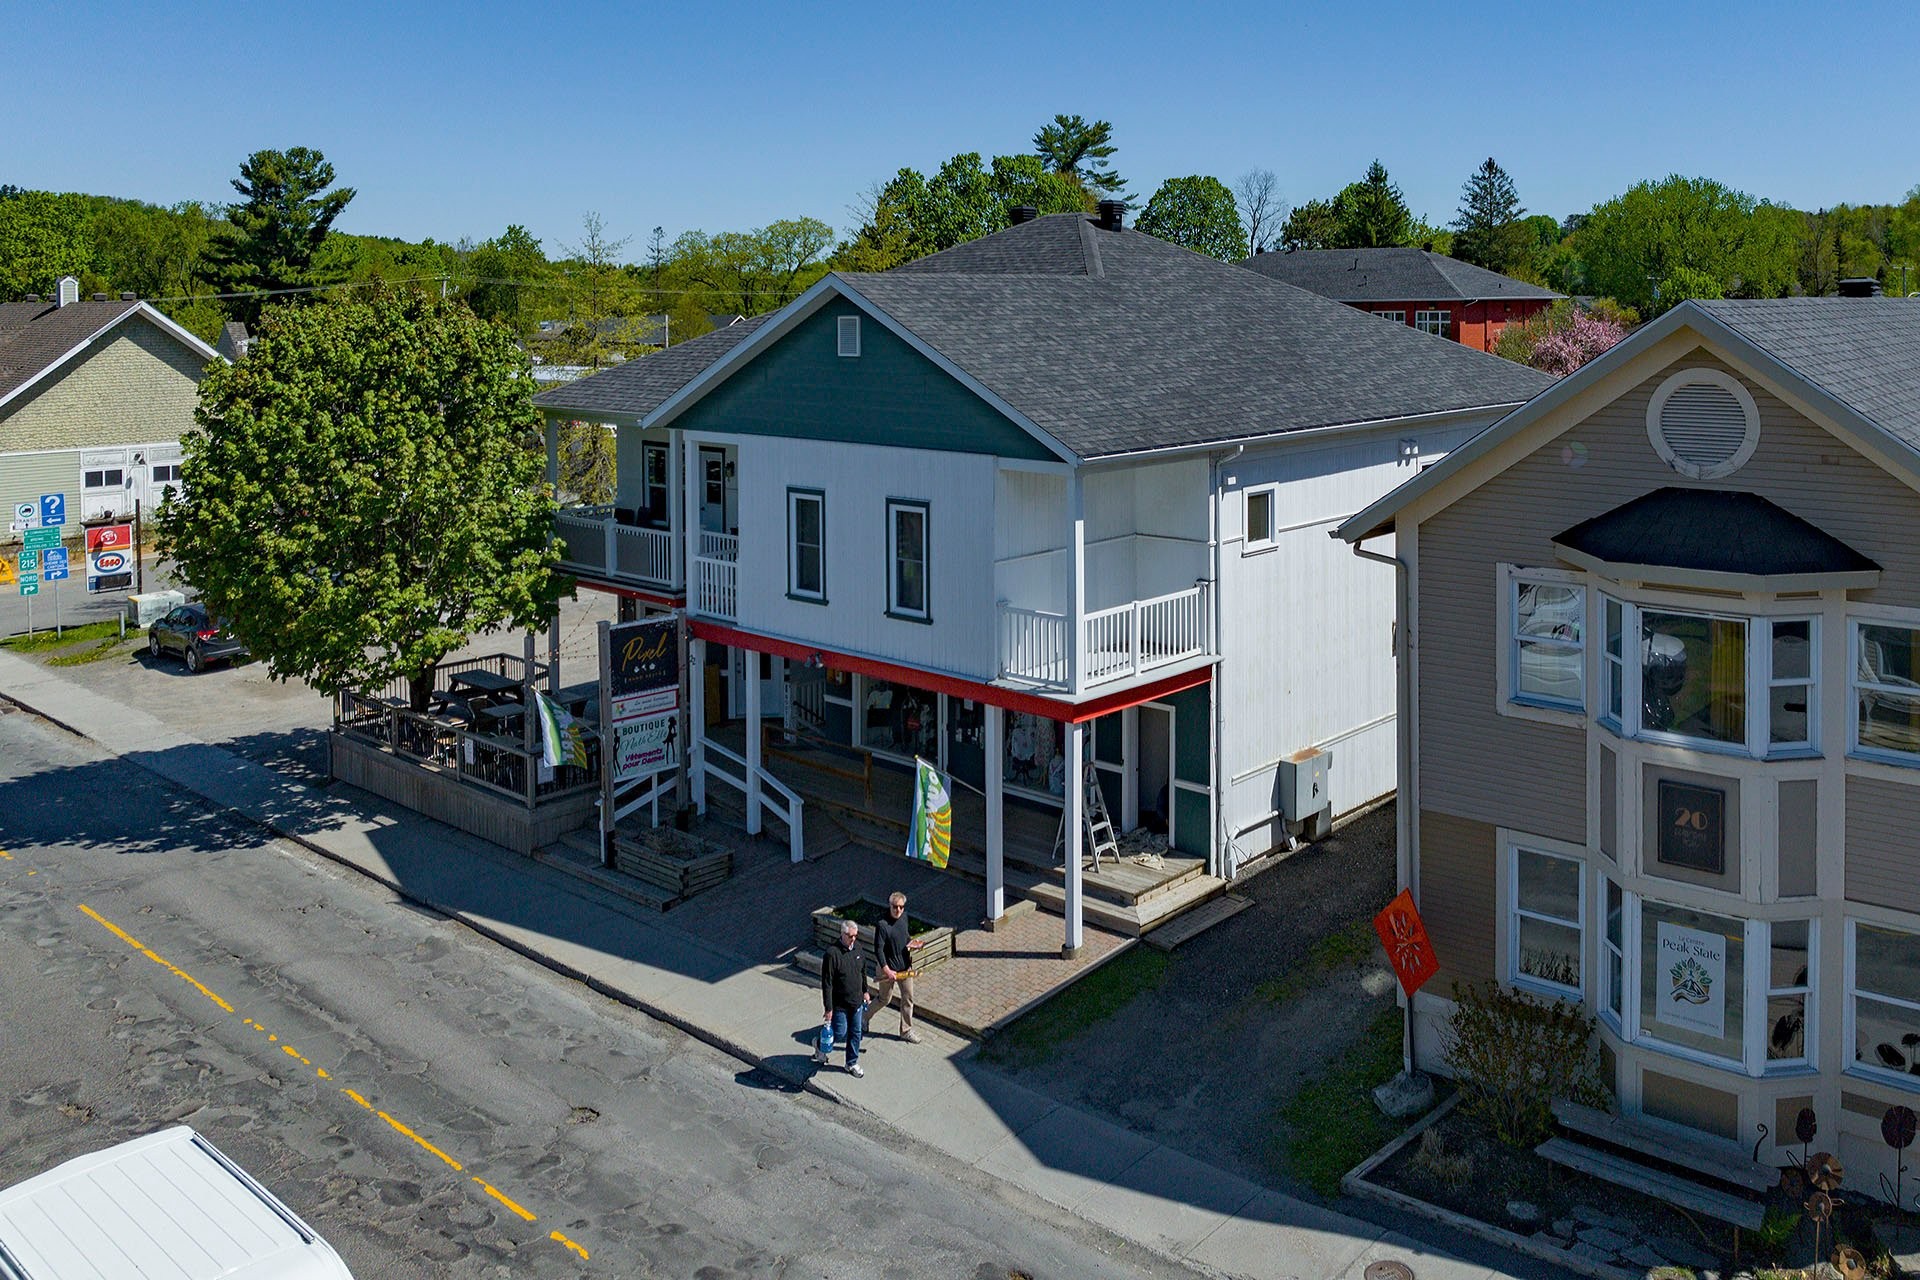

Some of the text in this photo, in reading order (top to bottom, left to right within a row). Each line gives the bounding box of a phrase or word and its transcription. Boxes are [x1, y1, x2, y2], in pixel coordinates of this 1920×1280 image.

[21, 559, 36, 569] 215
[622, 631, 668, 672] Pixel
[622, 719, 666, 736] BOUTIQUE
[625, 748, 663, 762] Vêtements
[622, 760, 640, 771] pour
[1675, 807, 1708, 830] 20
[1662, 938, 1721, 961] Peak State
